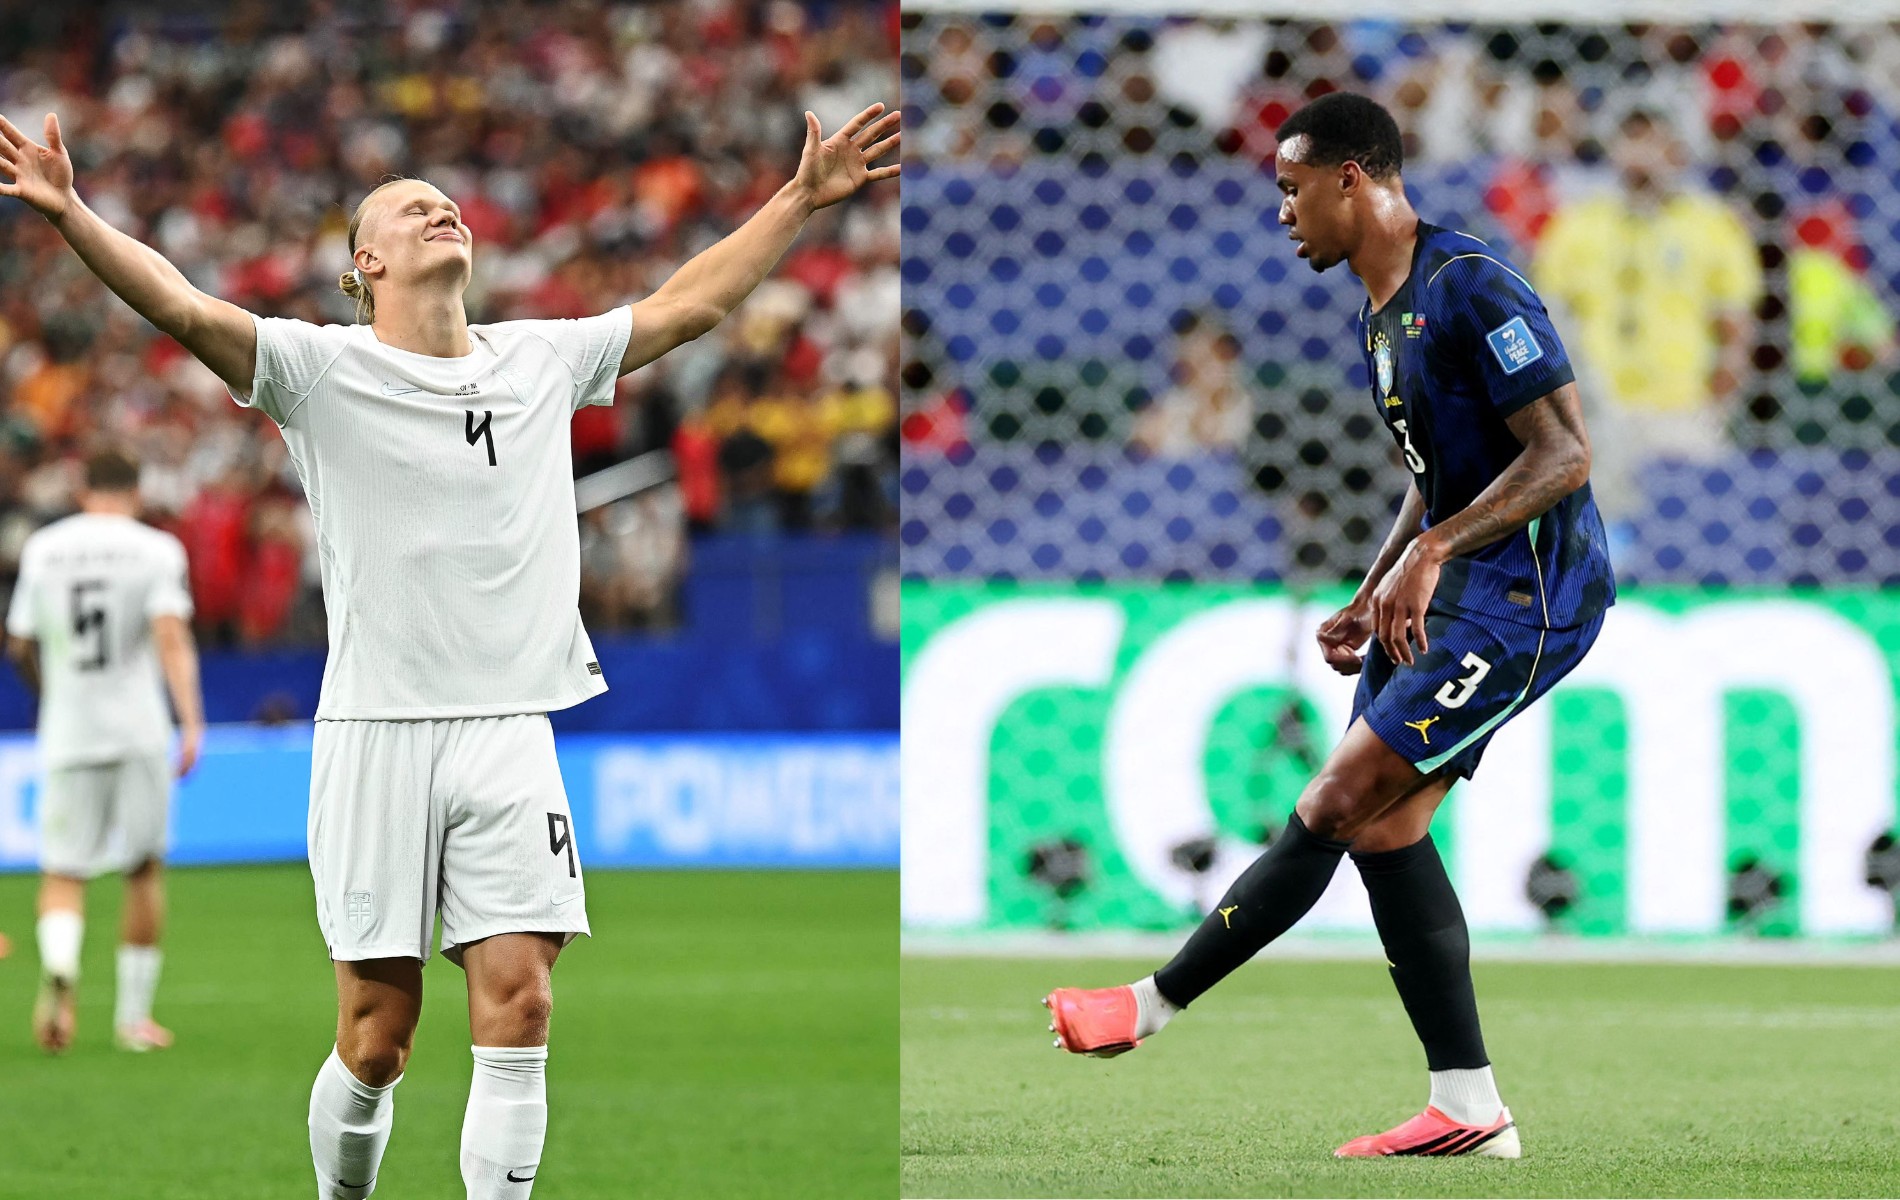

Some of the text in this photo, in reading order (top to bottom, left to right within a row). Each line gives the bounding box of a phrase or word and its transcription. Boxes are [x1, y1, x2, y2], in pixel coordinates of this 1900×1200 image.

[1508, 346, 1530, 362] PEACE
[1392, 419, 1426, 474] 3
[70, 578, 110, 673] 5
[1434, 651, 1492, 709] 3
[547, 812, 577, 879] 9
